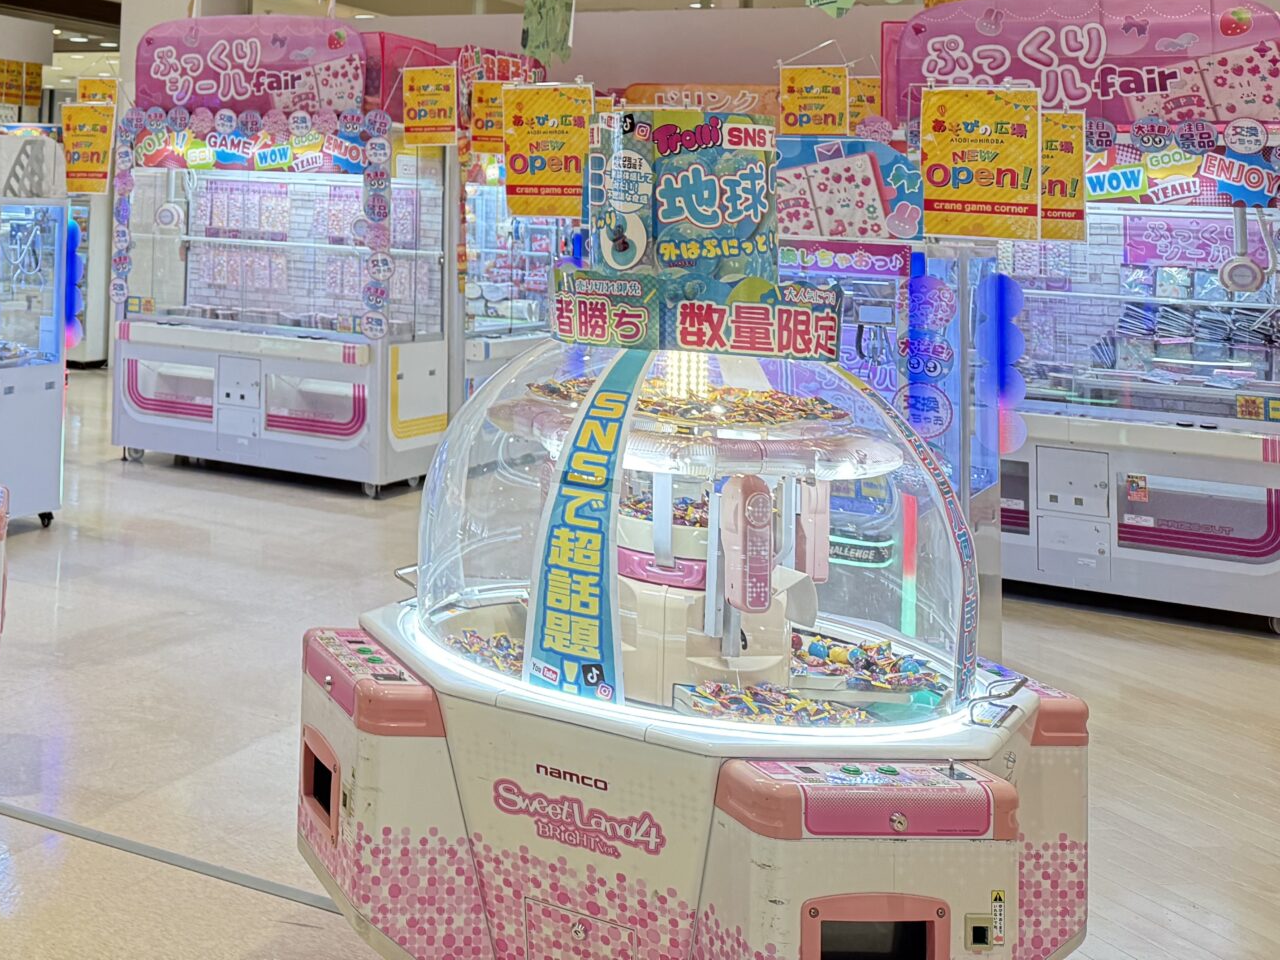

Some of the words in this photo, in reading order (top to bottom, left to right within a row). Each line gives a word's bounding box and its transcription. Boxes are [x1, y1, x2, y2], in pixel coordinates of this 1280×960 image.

[152, 39, 260, 76] ぷっくり
[922, 24, 1106, 79] ぷっくり
[252, 70, 302, 95] fair
[1094, 65, 1179, 99] fair
[652, 116, 723, 156] Trolli
[931, 117, 1028, 139] あそびの広場
[208, 134, 253, 155] GAME
[258, 146, 290, 165] WOW
[529, 141, 565, 153] NEW
[509, 153, 582, 175] Open
[952, 150, 999, 164] NEW
[926, 164, 1033, 191] Open!
[1088, 169, 1142, 193] WOW
[1204, 156, 1280, 194] ENJOY
[1151, 180, 1199, 202] YEAH!
[934, 202, 961, 211] crane
[964, 203, 992, 214] game
[995, 203, 1029, 213] corner
[678, 301, 838, 358] 数量限定
[536, 763, 608, 791] namco
